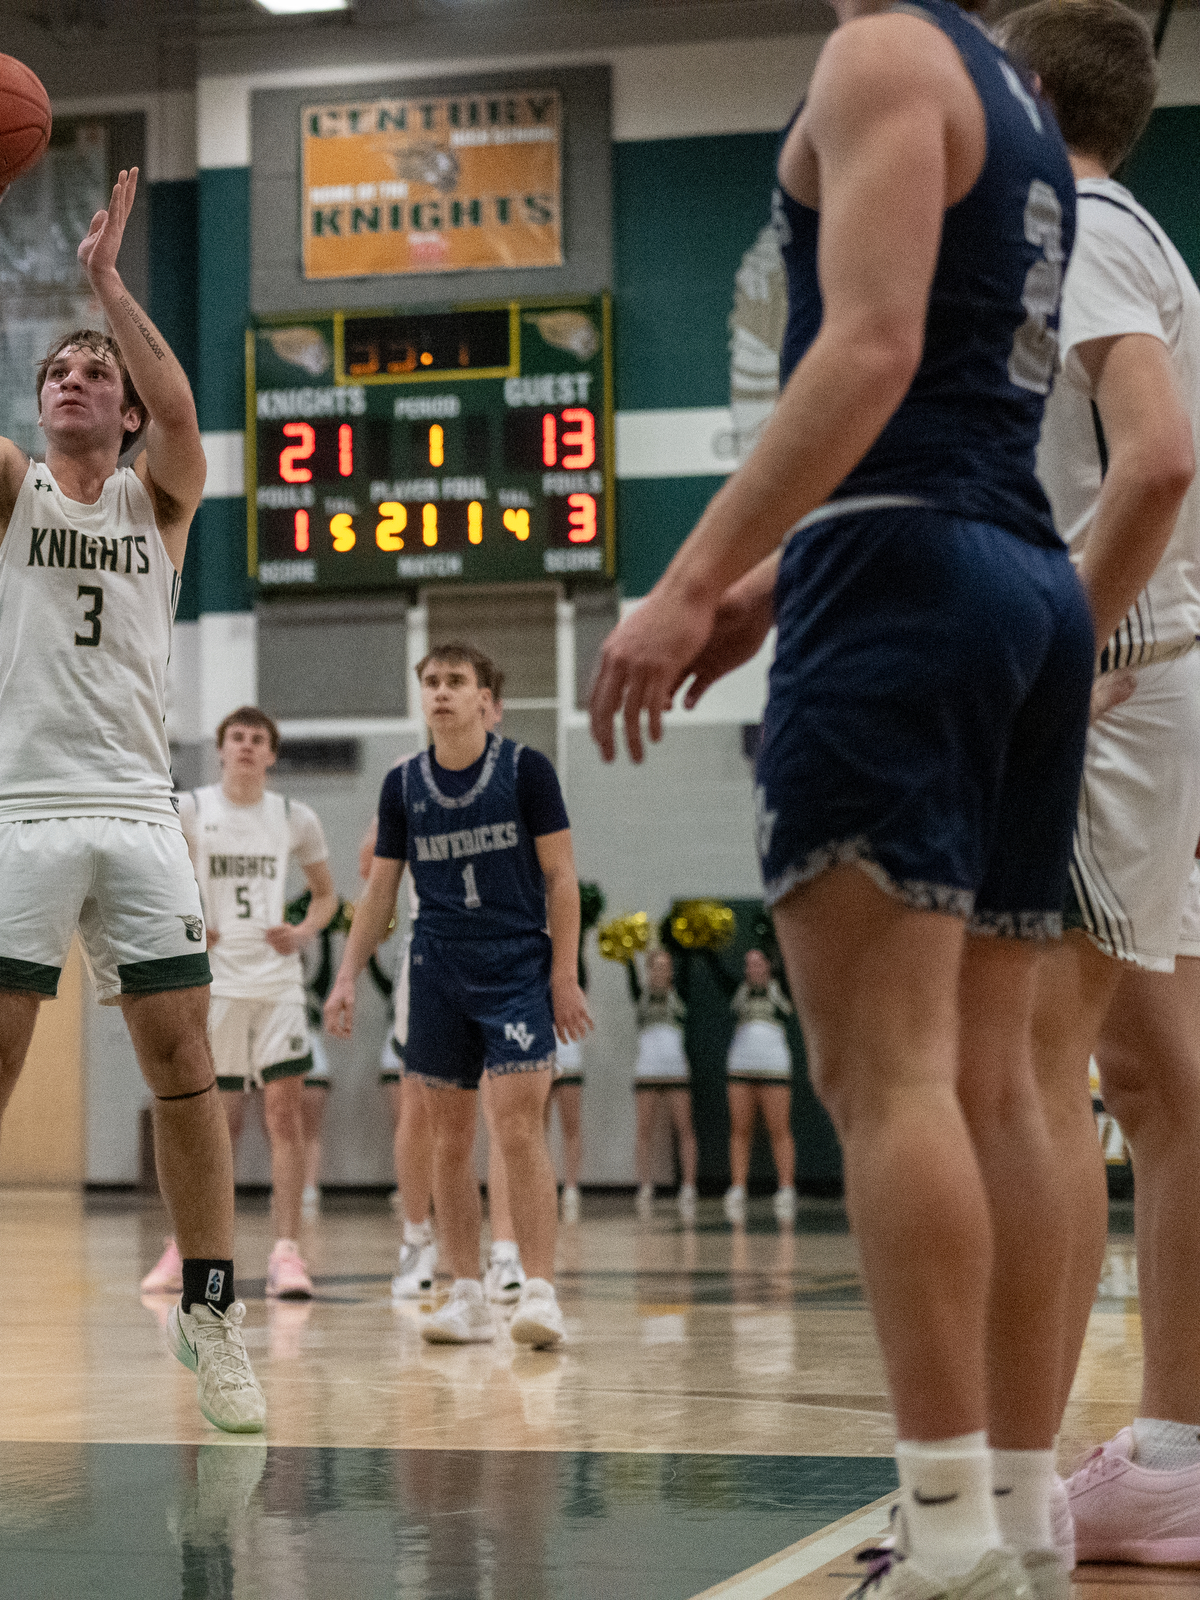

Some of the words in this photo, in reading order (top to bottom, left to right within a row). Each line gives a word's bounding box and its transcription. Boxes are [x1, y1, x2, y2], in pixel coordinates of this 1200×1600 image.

[308, 99, 554, 138] CENTURY
[311, 194, 553, 237] KNIGHTS
[257, 386, 366, 418] KNIGHTS
[504, 374, 591, 407] GUEST
[279, 422, 353, 483] 21
[429, 424, 444, 467] 1
[543, 408, 595, 469] 13
[294, 509, 310, 552] 1
[567, 493, 597, 543] 3
[27, 527, 150, 574] KNIGHTS
[74, 585, 104, 647] 3
[414, 820, 519, 862] MAVERICKS
[209, 854, 277, 880] KNIGHTS
[461, 862, 482, 910] 1
[235, 886, 251, 918] 5
